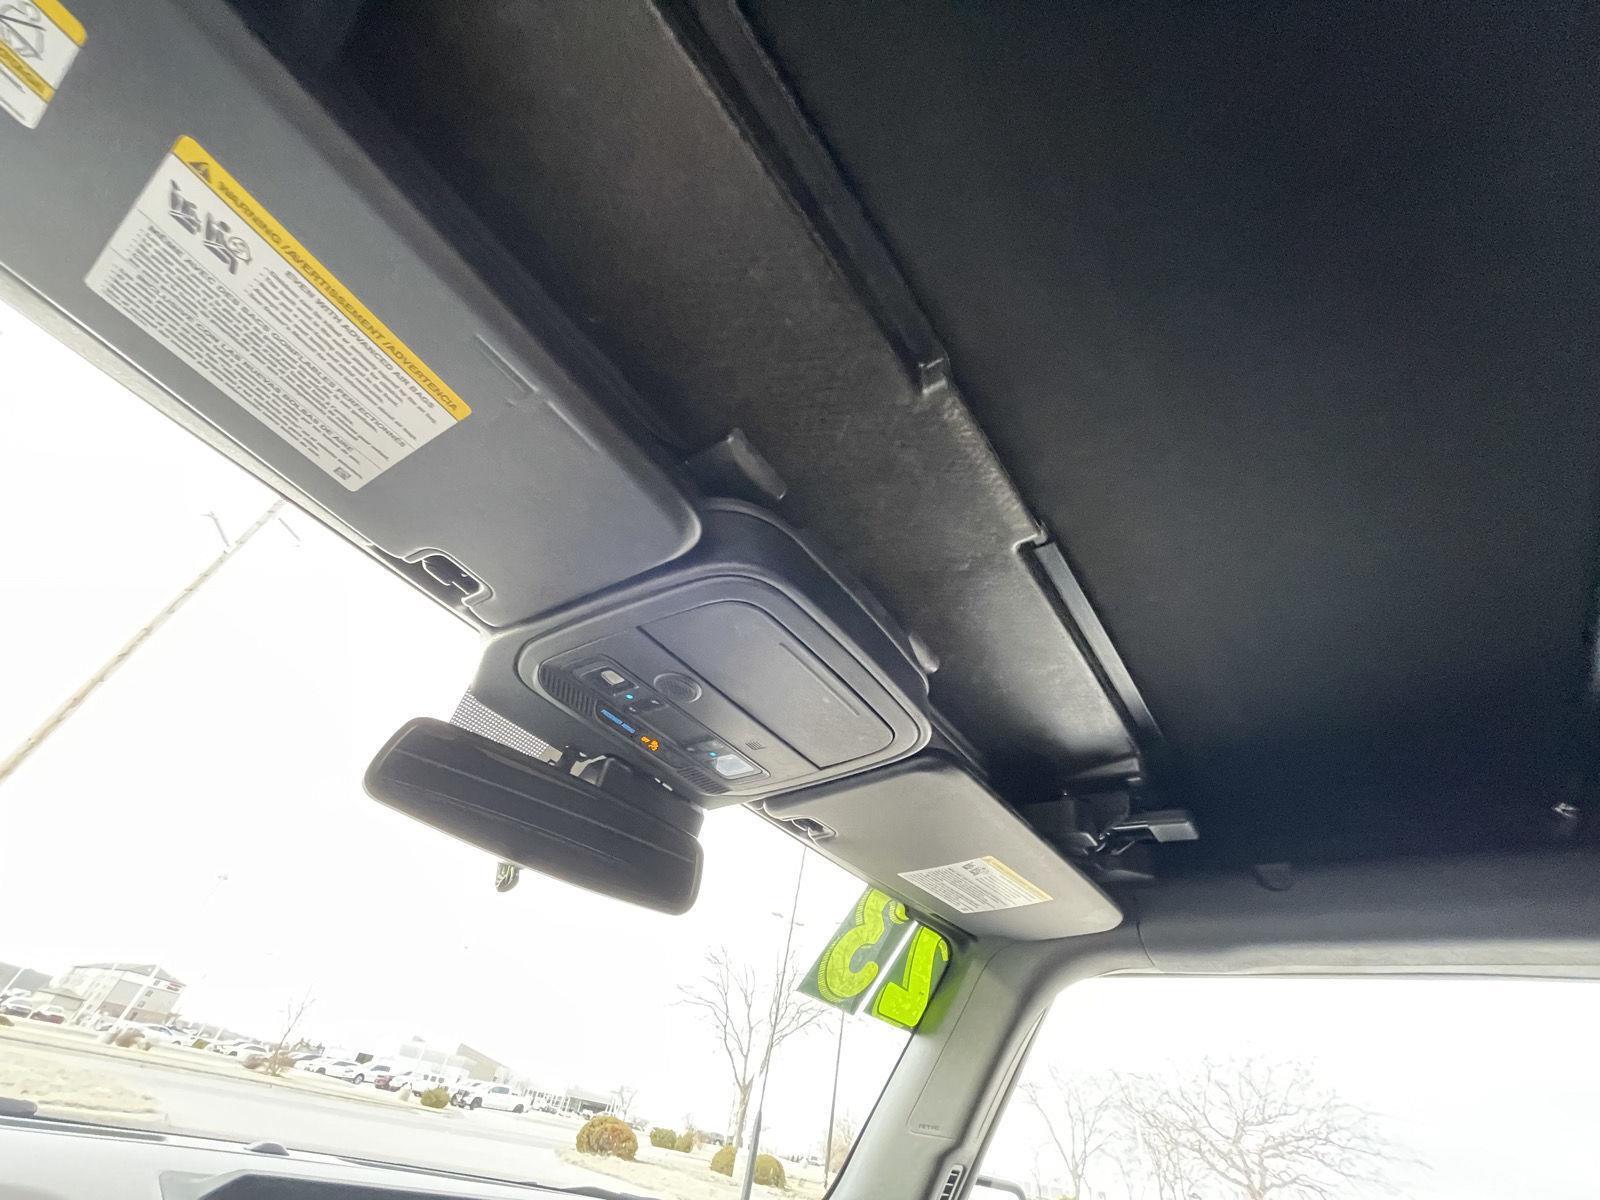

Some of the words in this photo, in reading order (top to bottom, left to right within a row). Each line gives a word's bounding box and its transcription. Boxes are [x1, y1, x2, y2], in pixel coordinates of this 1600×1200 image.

[183, 255, 216, 285] AVEC
[215, 283, 240, 306] DES
[240, 305, 270, 332] SACS
[284, 269, 315, 299] EVEN
[314, 297, 342, 323] WITH
[340, 321, 394, 371] ADVANCED
[391, 369, 410, 386] AIR
[408, 384, 435, 409] BAGS
[194, 322, 220, 343] CON
[220, 343, 242, 361] LAS
[319, 423, 333, 435] DE
[382, 339, 459, 411] /ADVERTENCIA
